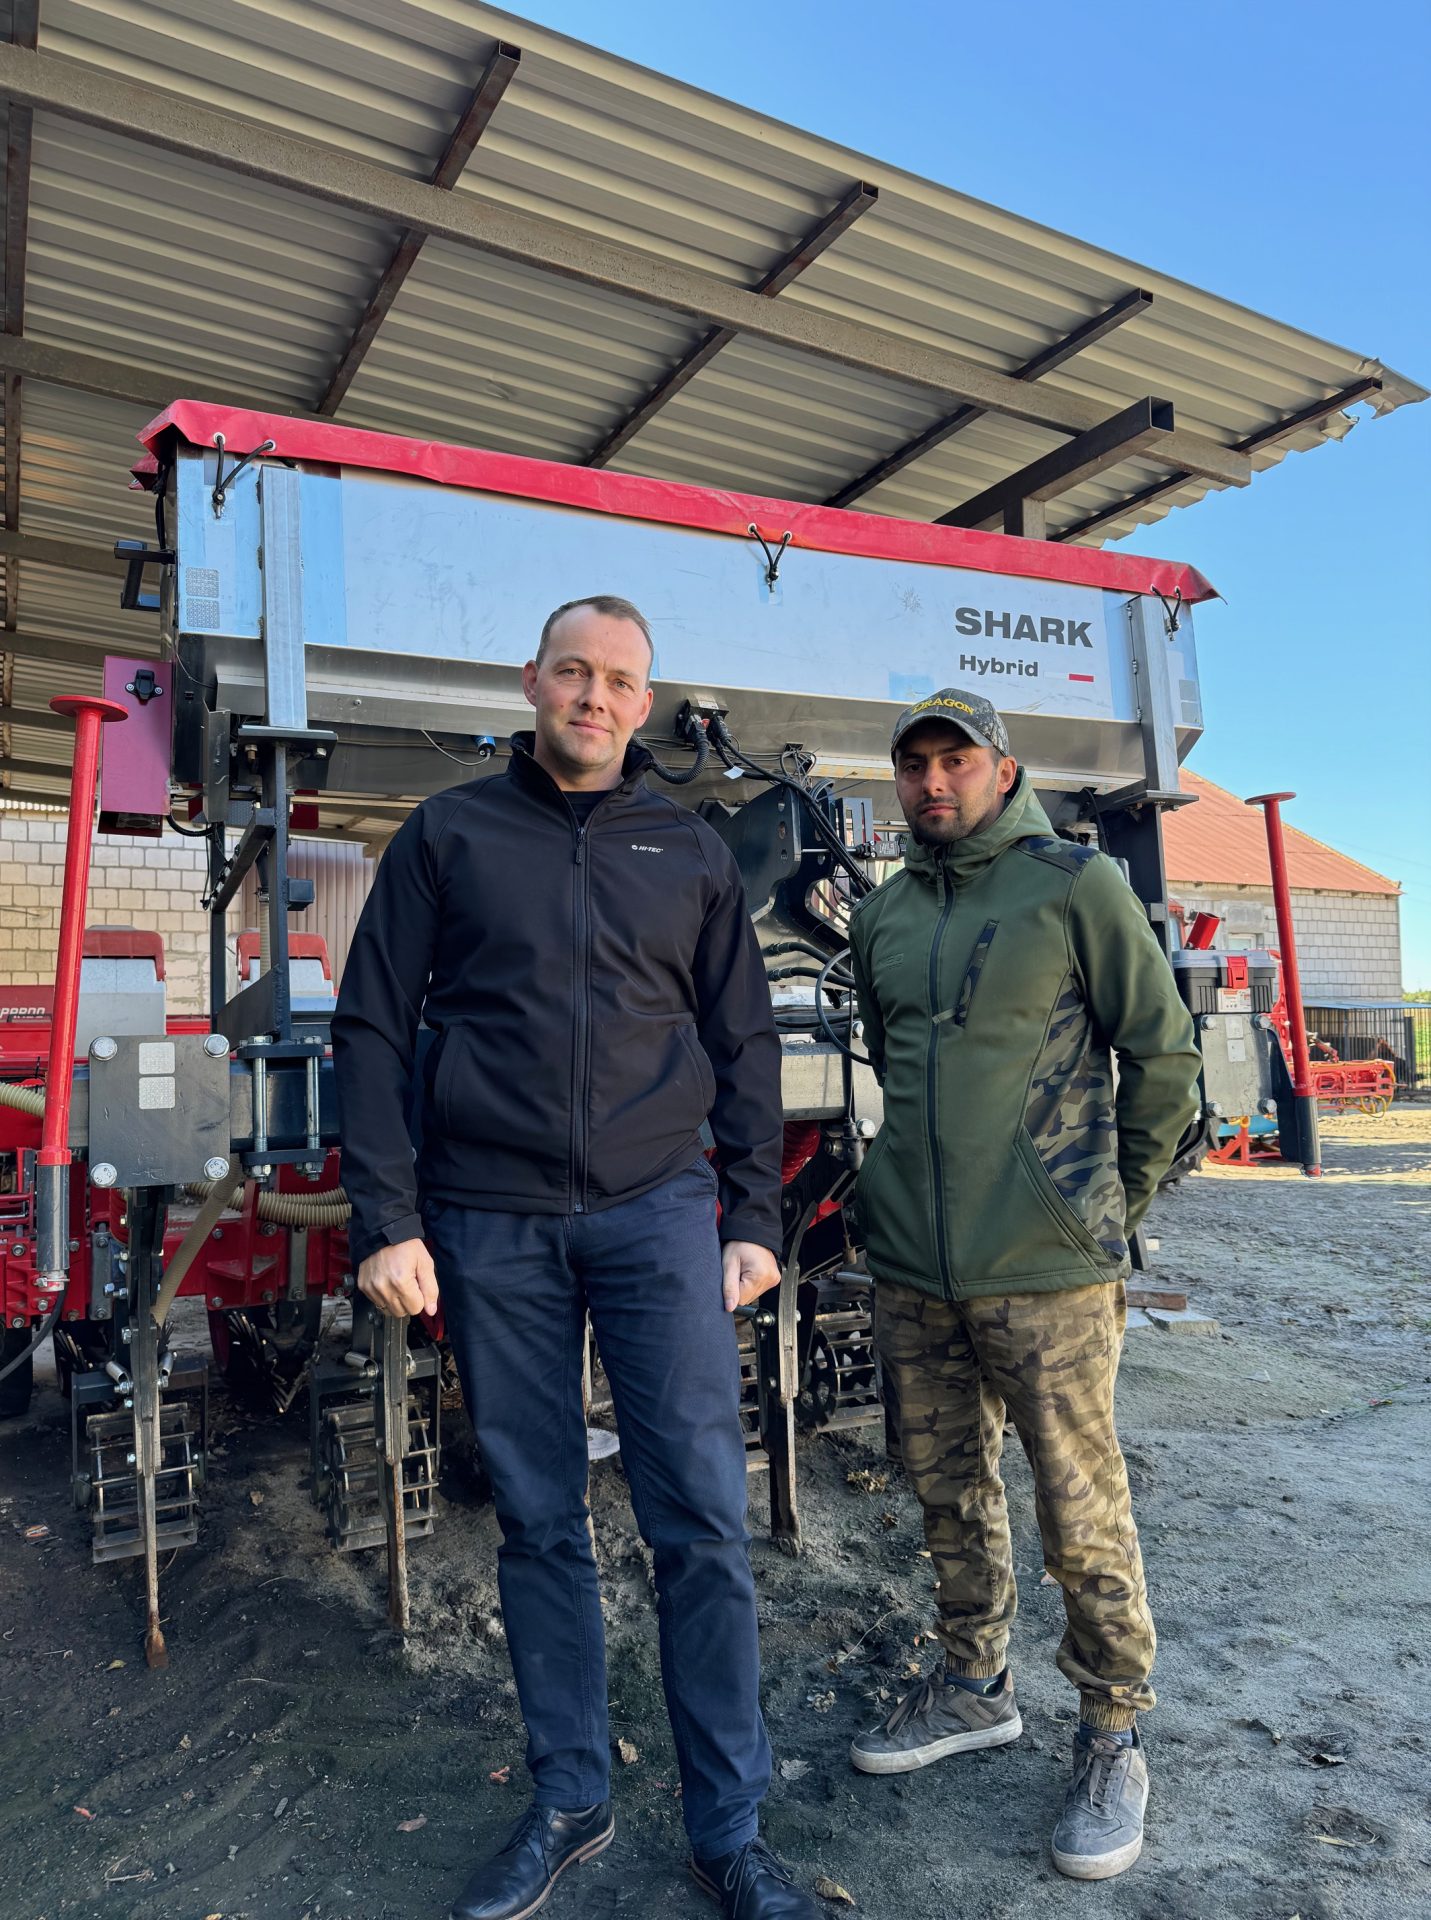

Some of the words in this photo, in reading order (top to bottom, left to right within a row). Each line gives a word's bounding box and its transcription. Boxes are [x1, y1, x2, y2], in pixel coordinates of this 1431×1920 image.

[955, 606, 1093, 648] SHARK
[959, 654, 1039, 677] Hybrid
[911, 697, 975, 716] DRAGON
